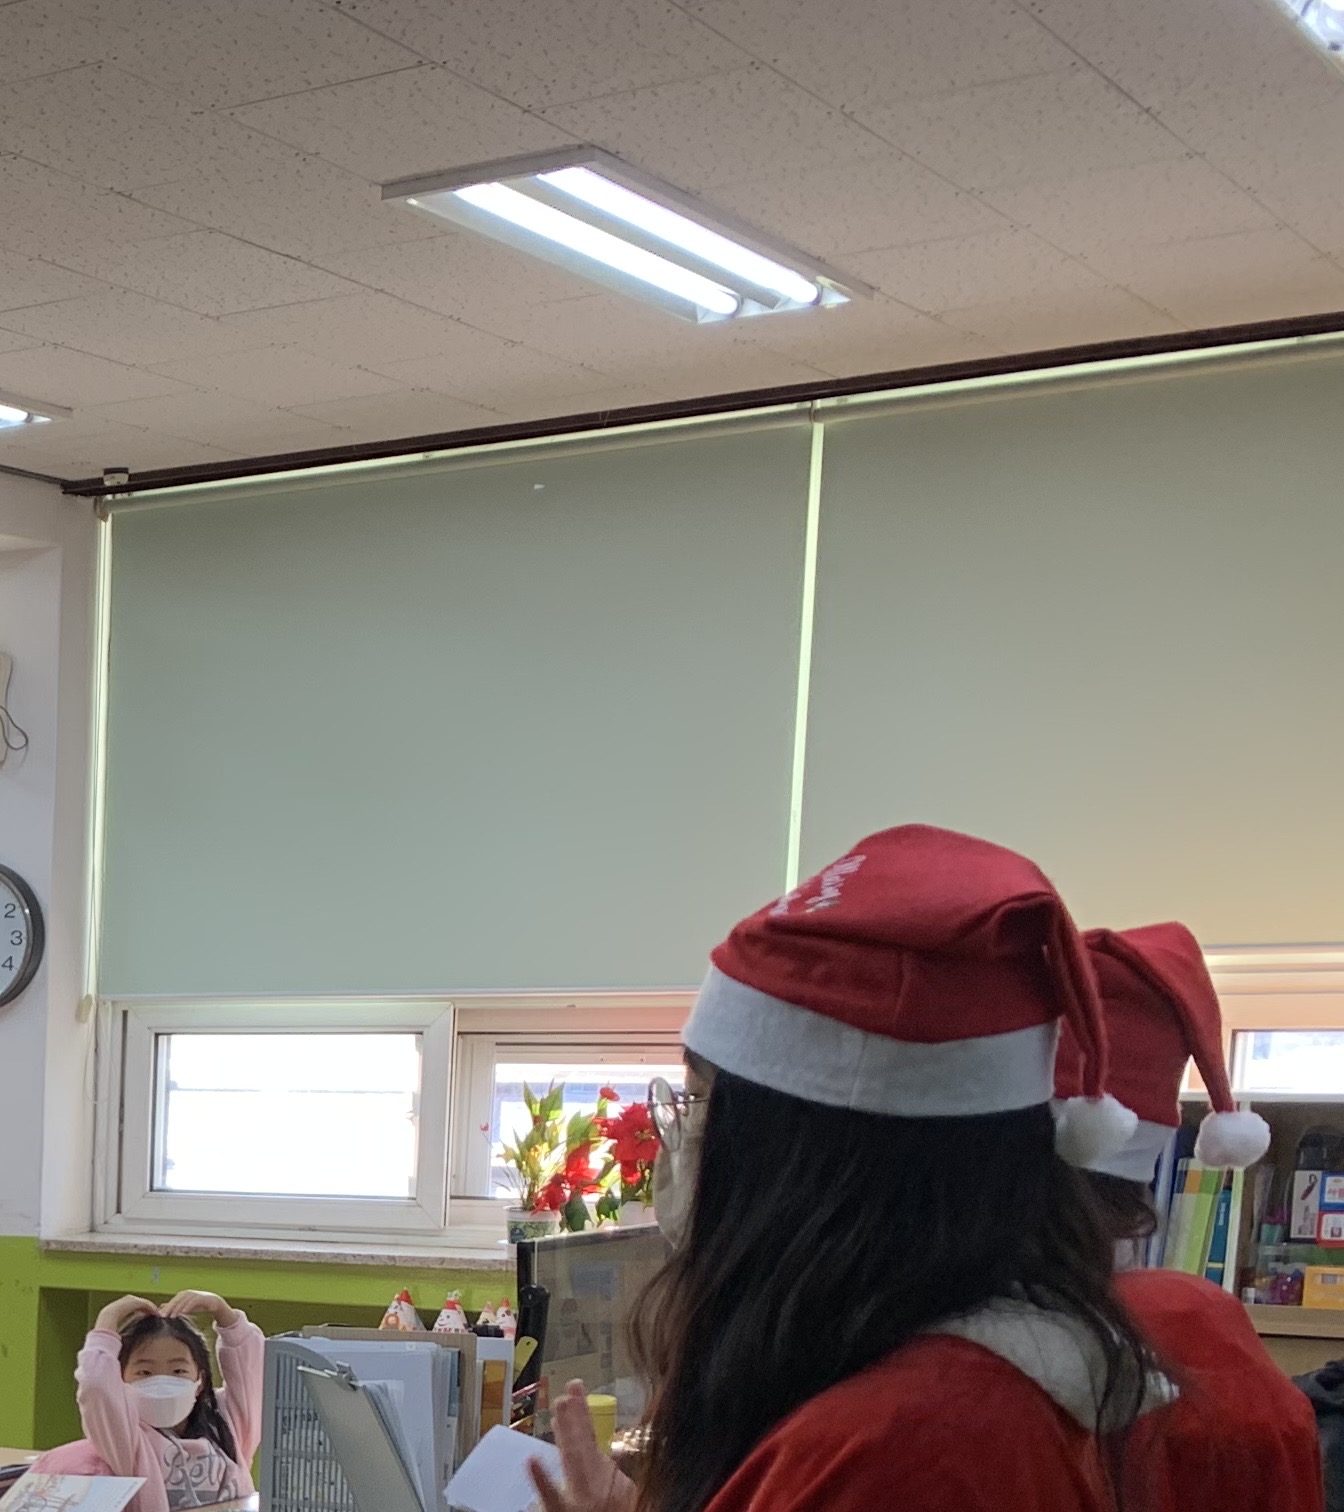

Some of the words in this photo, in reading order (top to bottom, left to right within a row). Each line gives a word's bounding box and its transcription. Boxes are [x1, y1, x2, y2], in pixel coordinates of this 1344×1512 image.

[4, 902, 16, 919] 2
[10, 929, 23, 946] 3
[1, 955, 14, 971] 4
